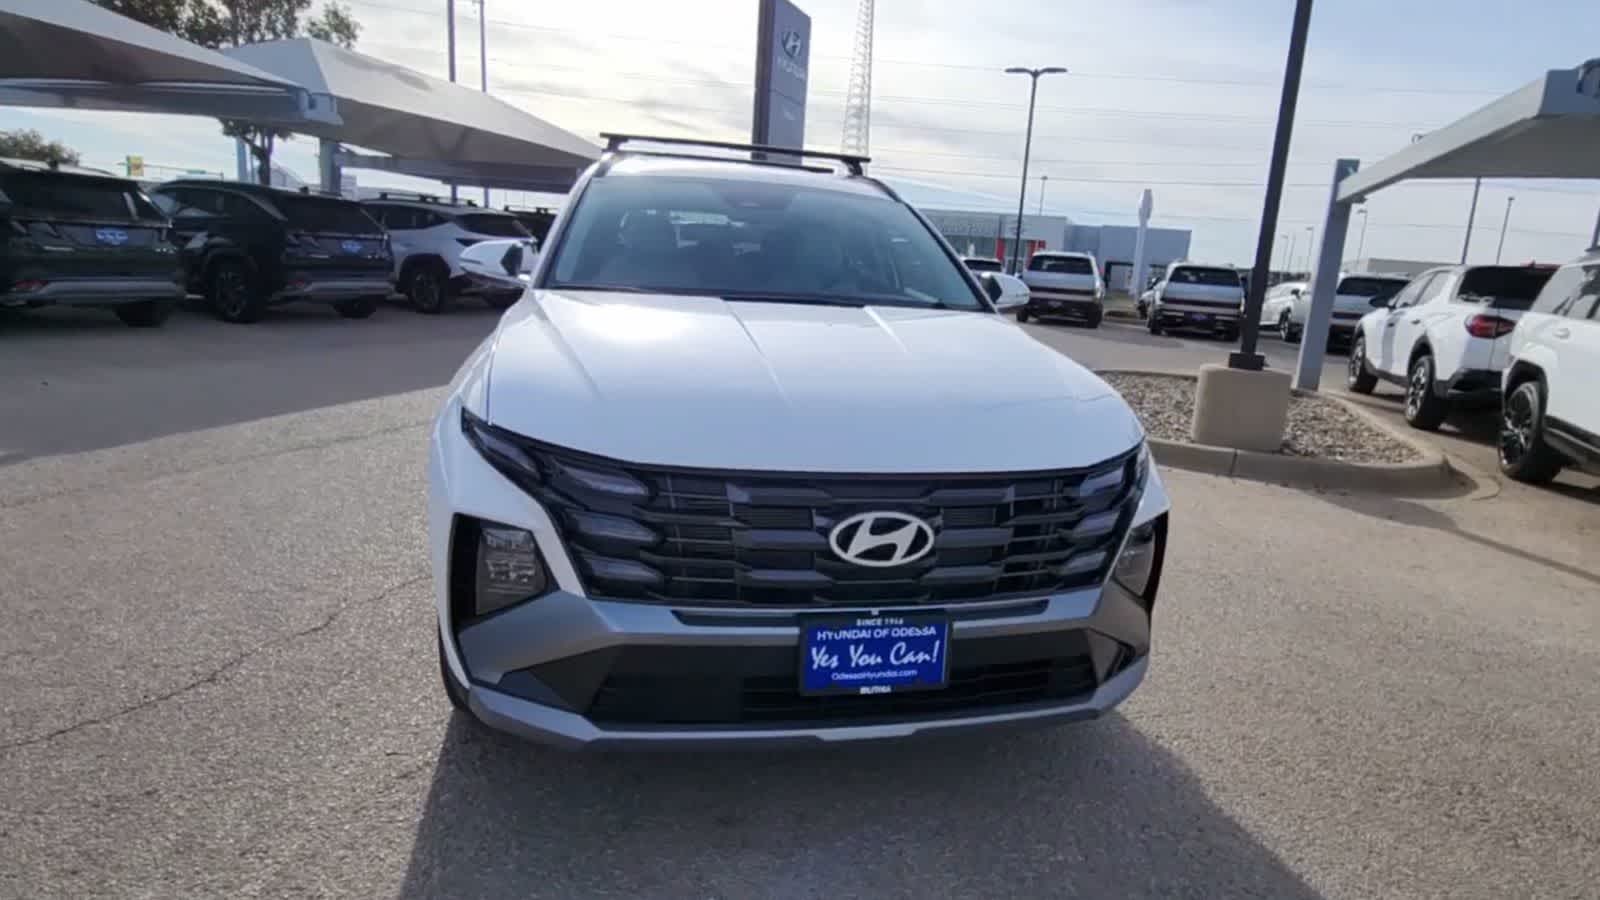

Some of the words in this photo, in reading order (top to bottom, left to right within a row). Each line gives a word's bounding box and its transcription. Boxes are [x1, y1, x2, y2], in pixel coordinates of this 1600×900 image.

[817, 630, 871, 640] HYUNDAI
[874, 629, 888, 638] OF
[891, 626, 936, 636] ODESSA
[811, 646, 839, 670] Yes
[850, 644, 882, 668] You
[890, 640, 940, 665] Can!
[831, 669, 917, 680] OdessaHyundai.com
